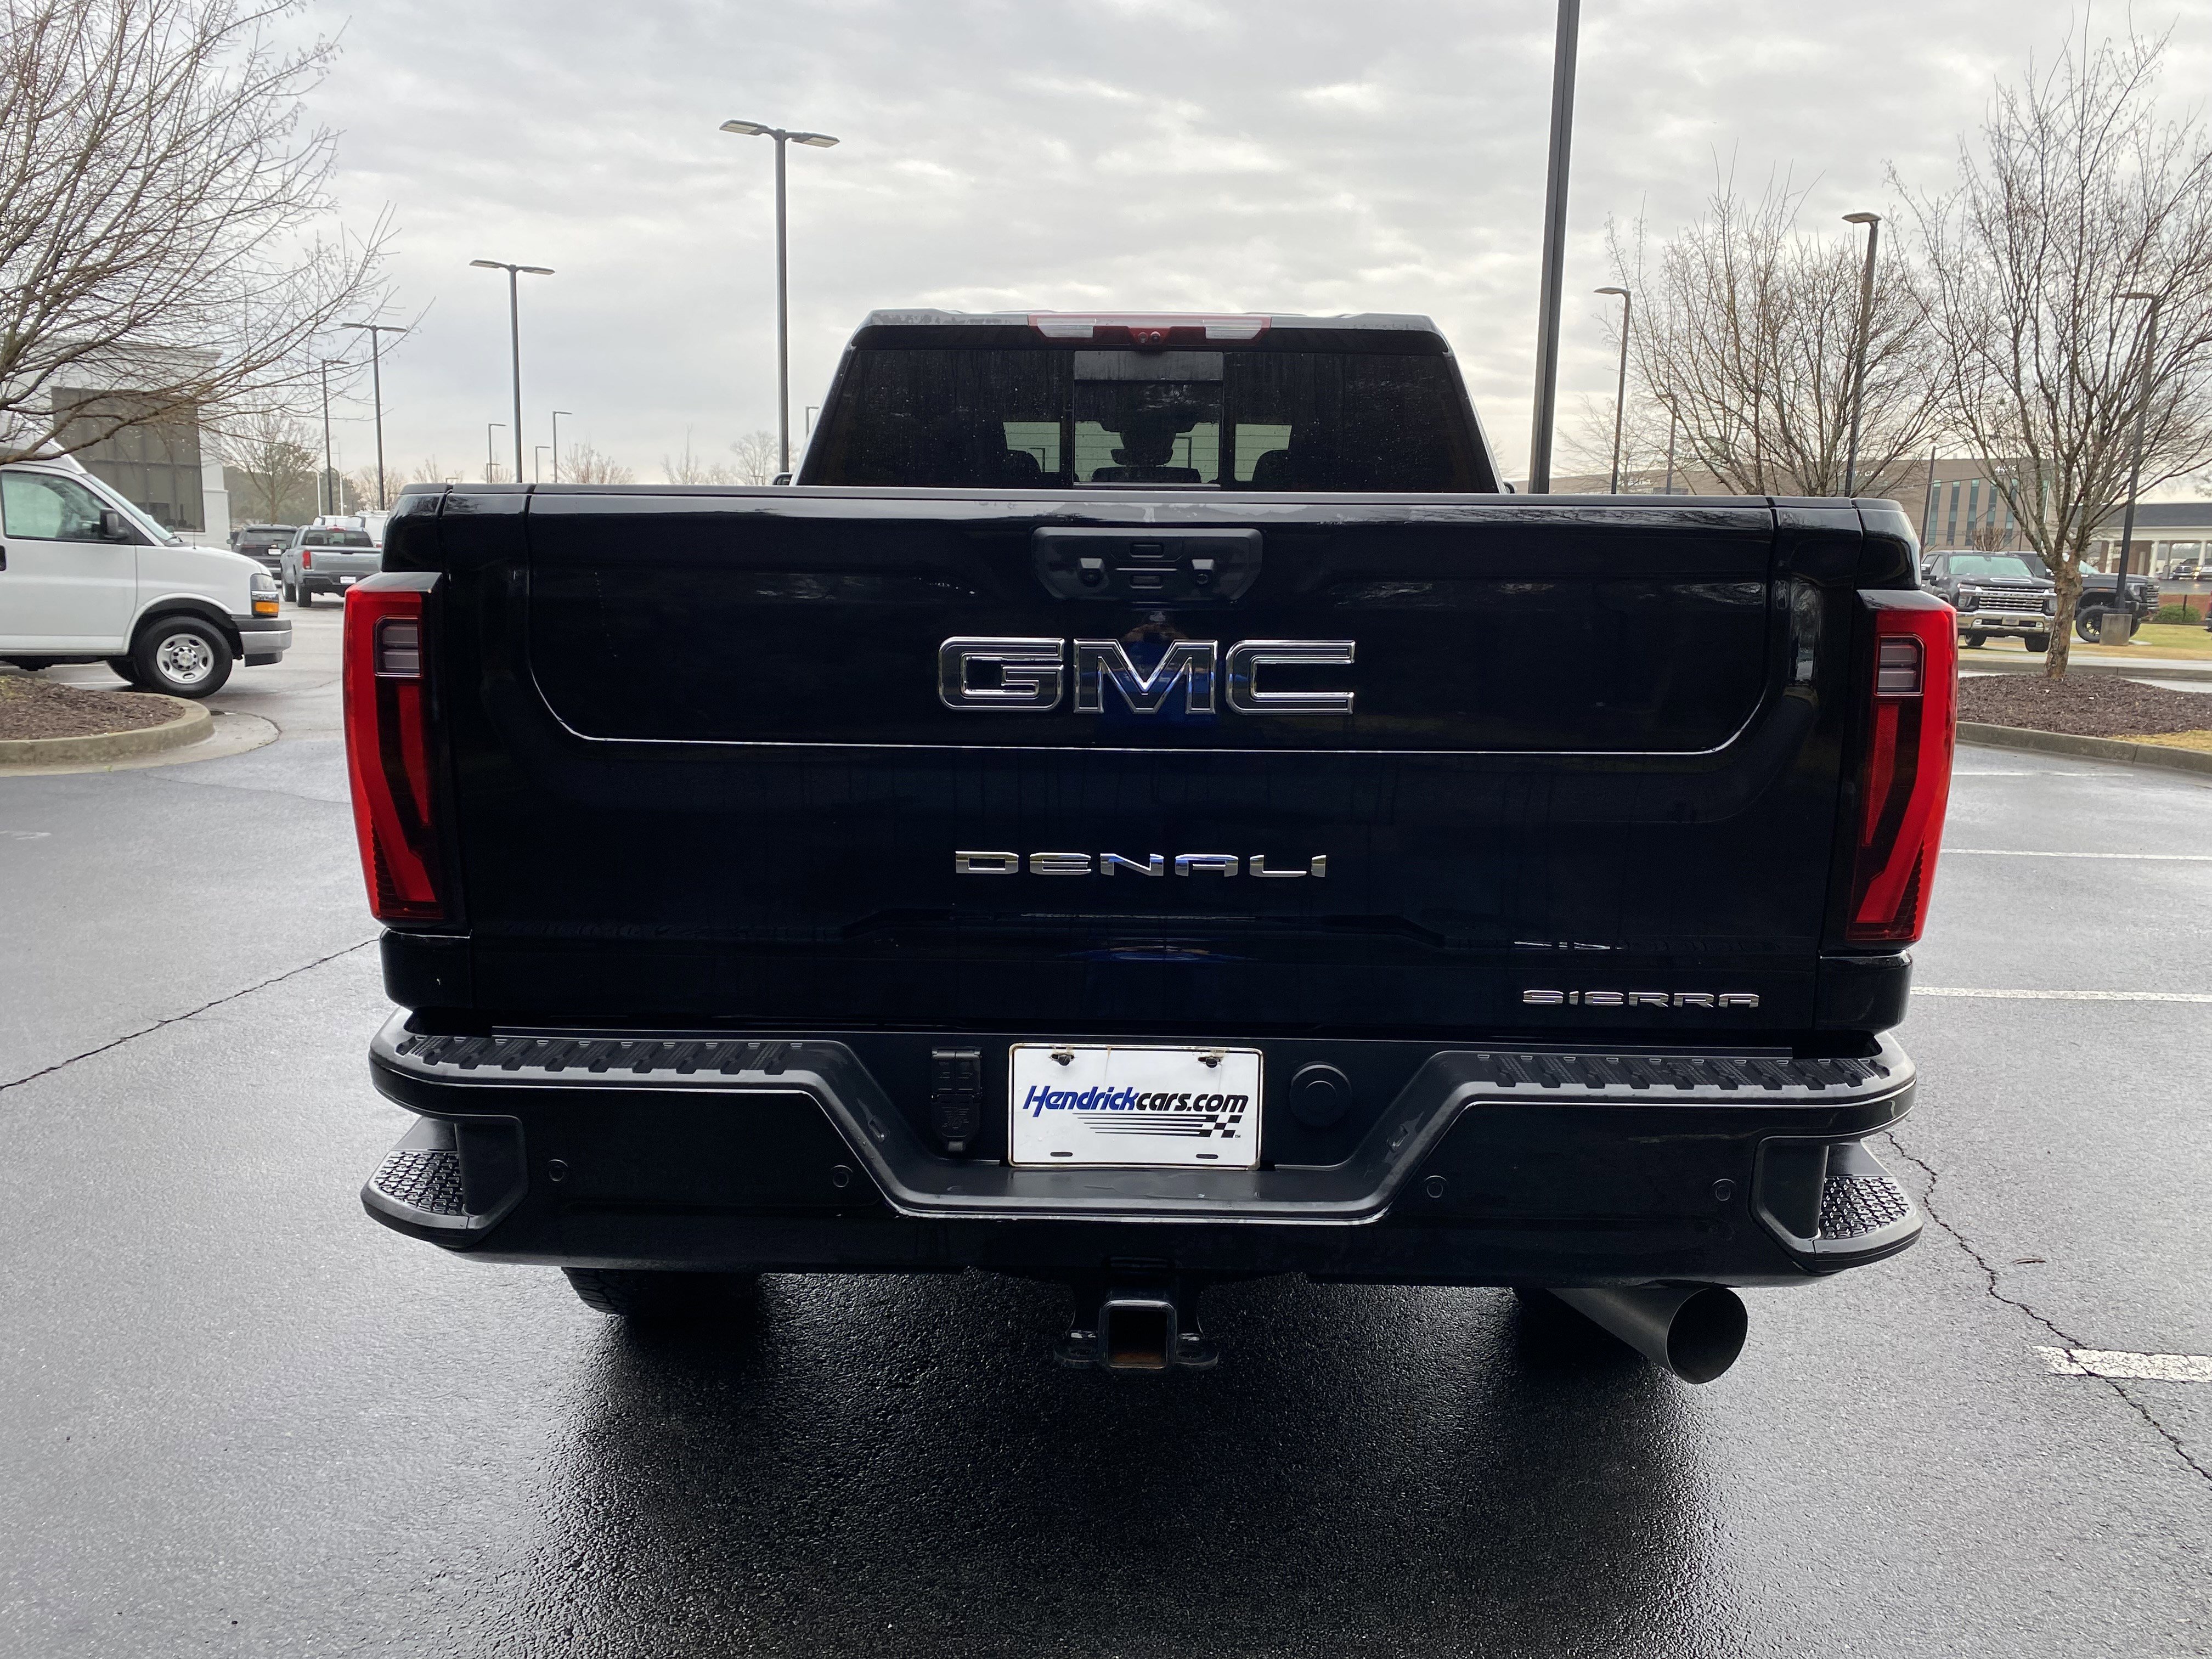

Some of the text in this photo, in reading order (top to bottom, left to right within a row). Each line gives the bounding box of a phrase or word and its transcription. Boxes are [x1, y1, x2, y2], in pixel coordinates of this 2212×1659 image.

[938, 636, 1356, 715] GMC
[955, 851, 1327, 878] DENALI
[1522, 990, 1759, 1008] SIERRA
[1023, 1085, 1249, 1117] Hendrickcars.com
